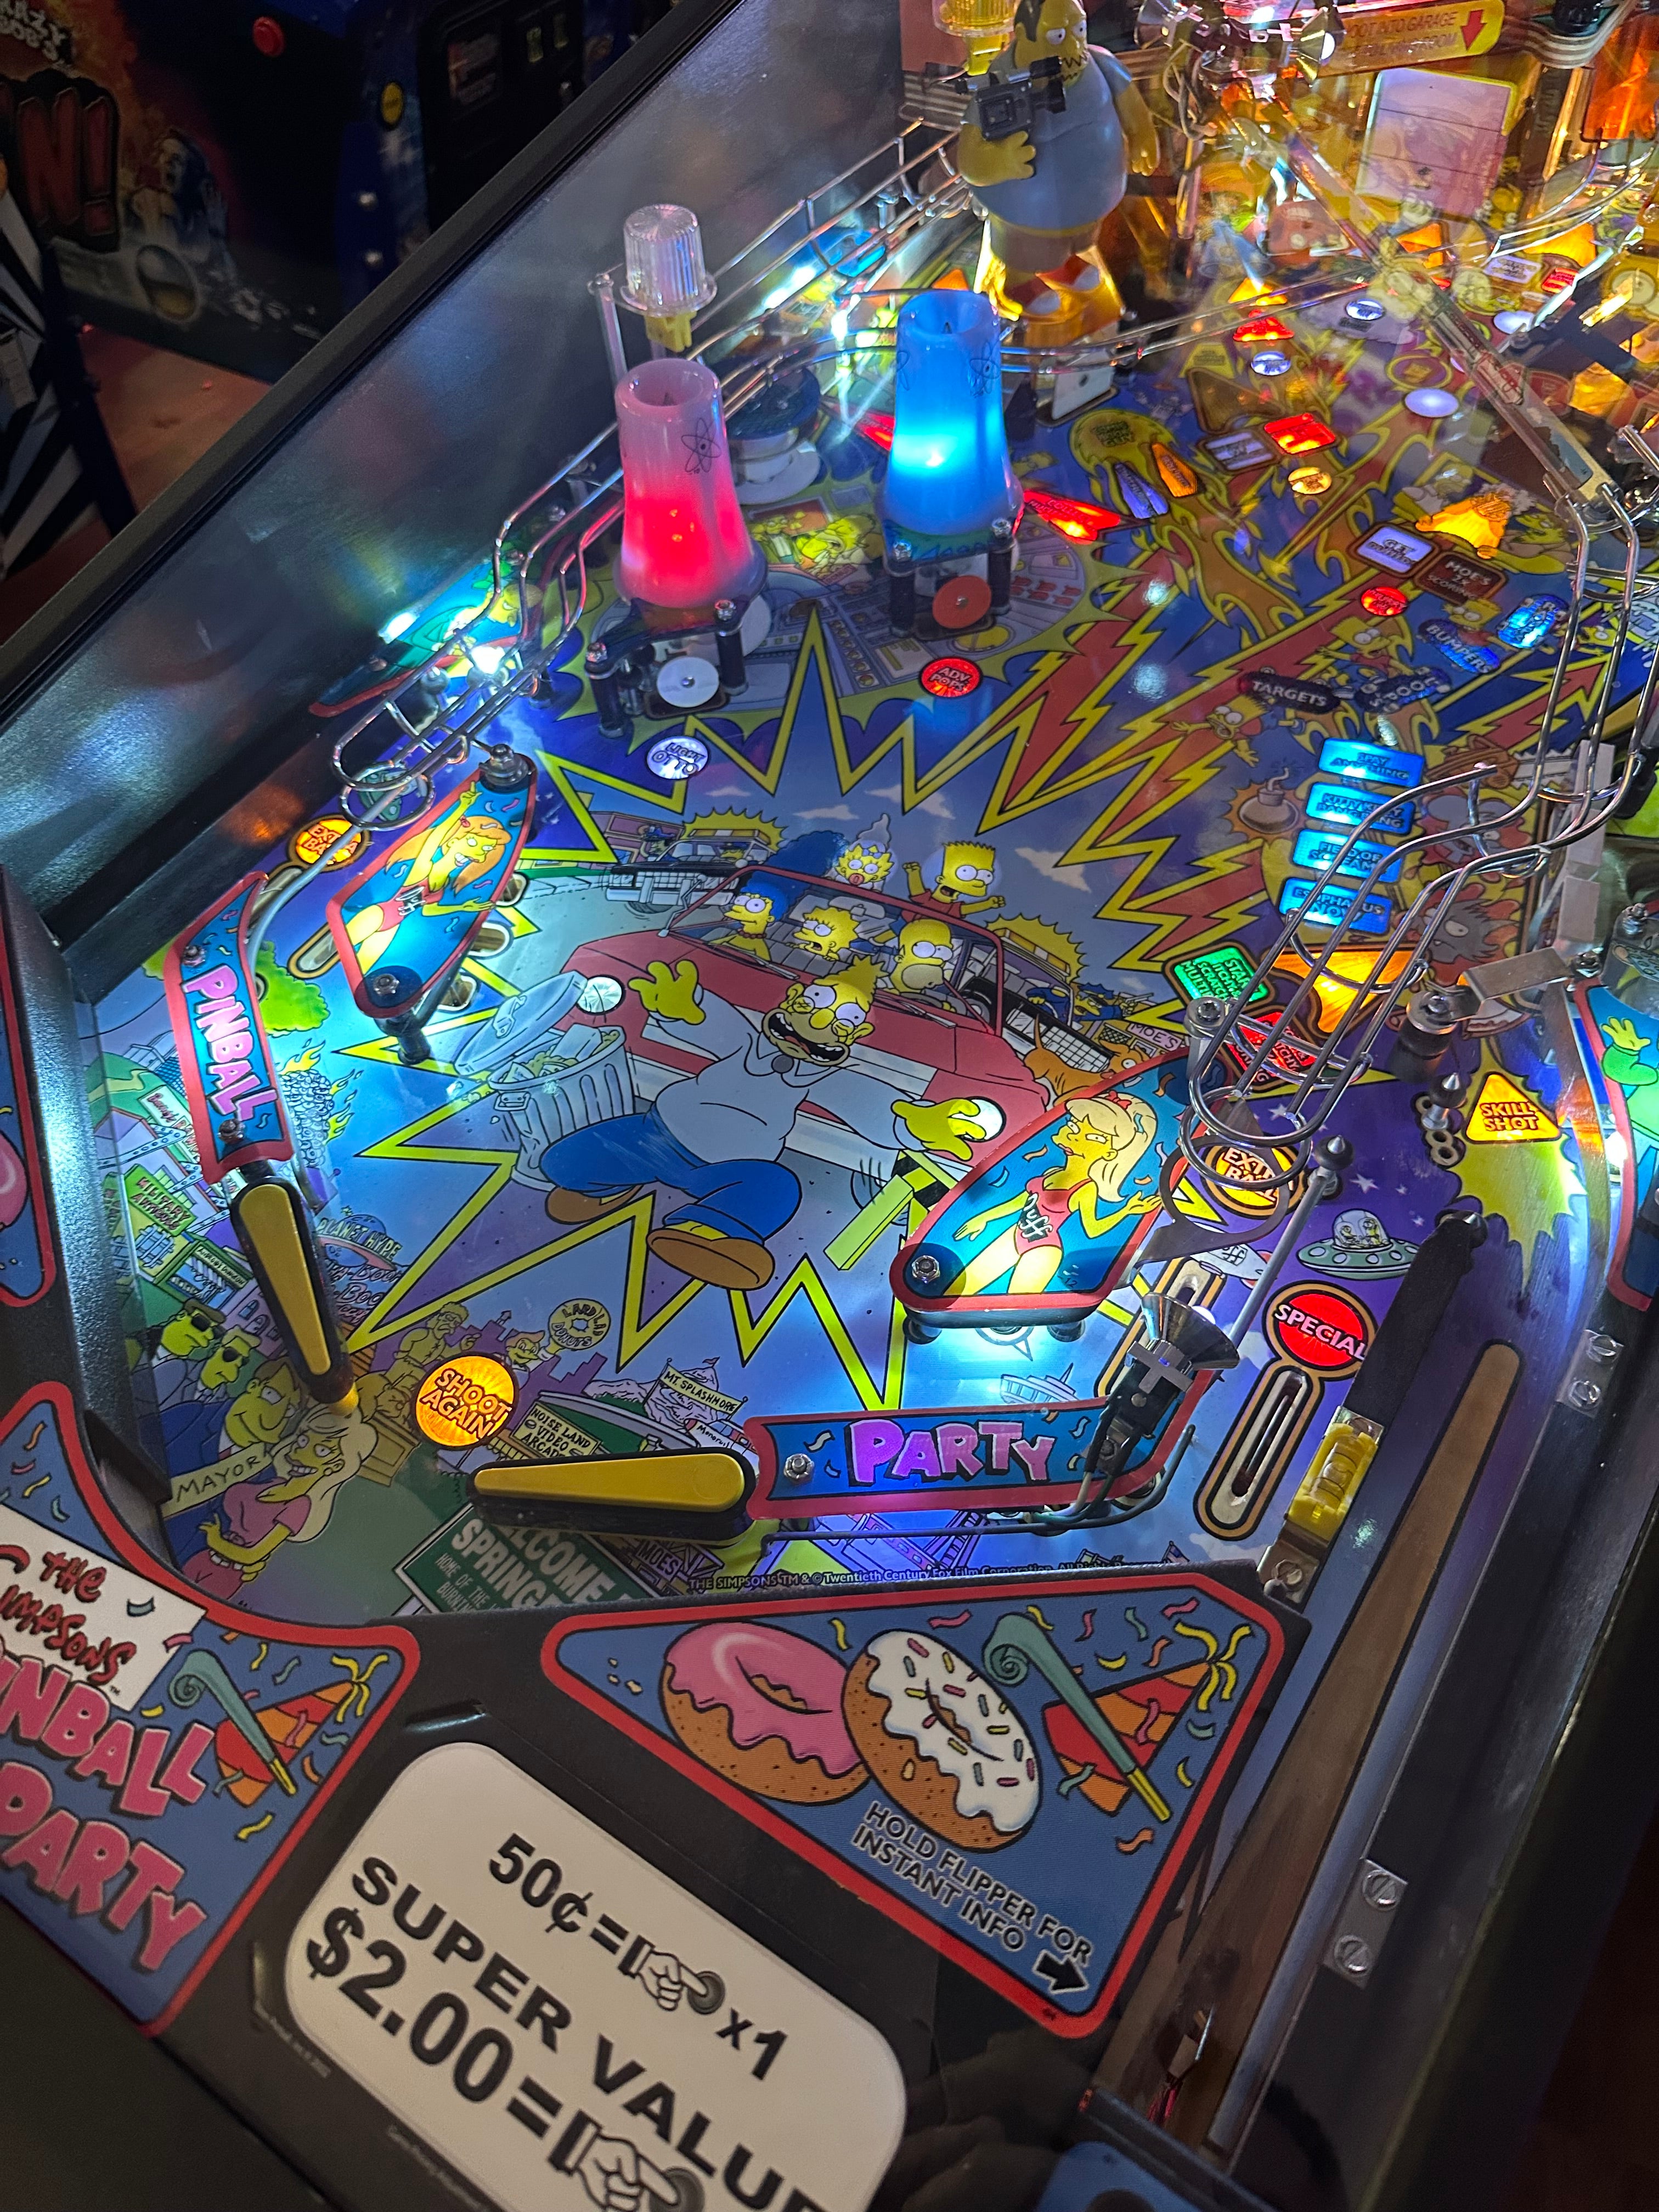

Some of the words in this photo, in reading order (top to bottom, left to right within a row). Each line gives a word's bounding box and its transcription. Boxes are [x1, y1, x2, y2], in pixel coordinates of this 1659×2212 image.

[1445, 560, 1492, 586] MOE'S
[1426, 624, 1493, 674] BUMPERS
[1252, 681, 1328, 707] TARGETS
[652, 750, 698, 775] OTTO
[665, 742, 706, 763] LIGHT
[308, 824, 358, 854] EXTA
[1319, 842, 1359, 857] FIED
[1361, 850, 1384, 862] OF
[1294, 888, 1384, 915] ESPHAUS
[1198, 962, 1229, 1002] SCRATCH
[1225, 960, 1261, 992] STAR
[180, 963, 280, 1124] PINBALL
[1131, 1024, 1178, 1049] MOE'S
[1480, 1103, 1534, 1116] SKILL
[1483, 1116, 1537, 1131] SHOT
[137, 1176, 190, 1221] MILITARY
[315, 1217, 370, 1243] PLANET
[363, 1231, 404, 1261] HYPE
[551, 1321, 592, 1347] DONUTS
[561, 1303, 597, 1318] LARD
[593, 1314, 607, 1336] LAD
[1274, 1304, 1366, 1361] SPECIAL
[421, 1389, 494, 1439] AGAIN
[436, 1368, 512, 1421] SHOOT
[680, 1380, 738, 1412] SPLASHMORE
[531, 1408, 563, 1432] NOISE
[561, 1428, 591, 1448] LAND
[537, 1425, 569, 1451] VIDEO
[848, 1418, 1057, 1486] PARTY
[177, 1455, 261, 1503] MAYOR
[40, 1551, 107, 1603] THE
[436, 1552, 461, 1578] HOME
[455, 1573, 473, 1589] OF
[470, 1584, 492, 1608] THE
[451, 1518, 564, 1607] SPRING
[495, 1526, 616, 1604] LCOME
[689, 1578, 713, 1590] THE
[716, 1576, 777, 1590] SIMPSONS
[801, 1573, 810, 1583] &
[823, 1570, 882, 1584] Twentieth
[884, 1568, 932, 1582] Century
[933, 1567, 952, 1578] Fox
[955, 1565, 979, 1577] Film
[0, 1544, 137, 1687] IMPSONS
[0, 1651, 216, 1819] NBALL
[852, 1824, 962, 1908] INSTANT
[961, 1897, 1026, 1951] INFO
[864, 1801, 939, 1861] HOLD
[938, 1848, 1036, 1929] FLIPPER
[1037, 1915, 1093, 1967] FOR
[351, 1857, 573, 2053] SUPER
